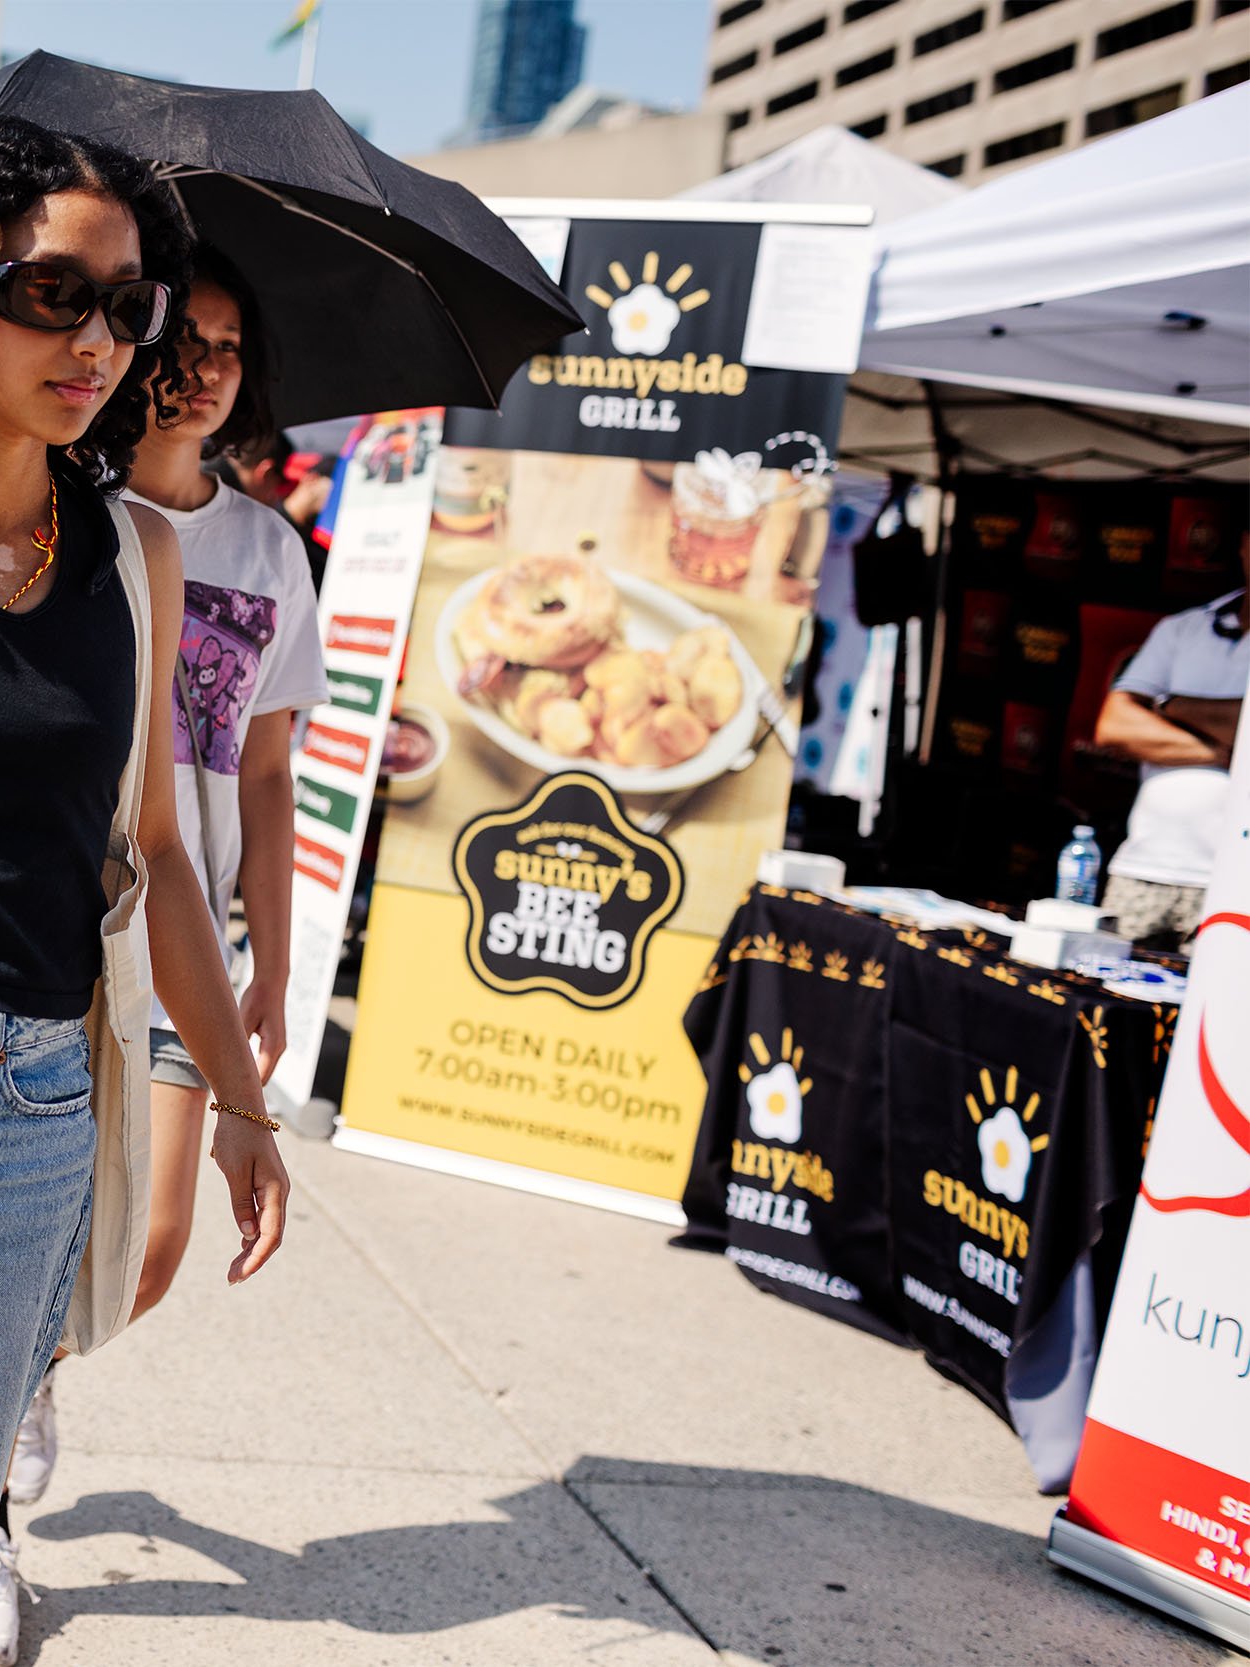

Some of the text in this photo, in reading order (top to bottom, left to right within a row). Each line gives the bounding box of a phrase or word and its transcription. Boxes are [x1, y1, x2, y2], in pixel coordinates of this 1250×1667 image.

[527, 352, 749, 400] sunnyside
[578, 394, 682, 433] GRILL
[493, 849, 653, 904] sunny's
[513, 880, 602, 930] BEE
[486, 911, 628, 974] STING
[449, 1018, 659, 1082] OPEN DAILY
[958, 1240, 1024, 1306] GRIL
[1159, 1499, 1242, 1556] HINDI,
[1195, 1547, 1217, 1574] &
